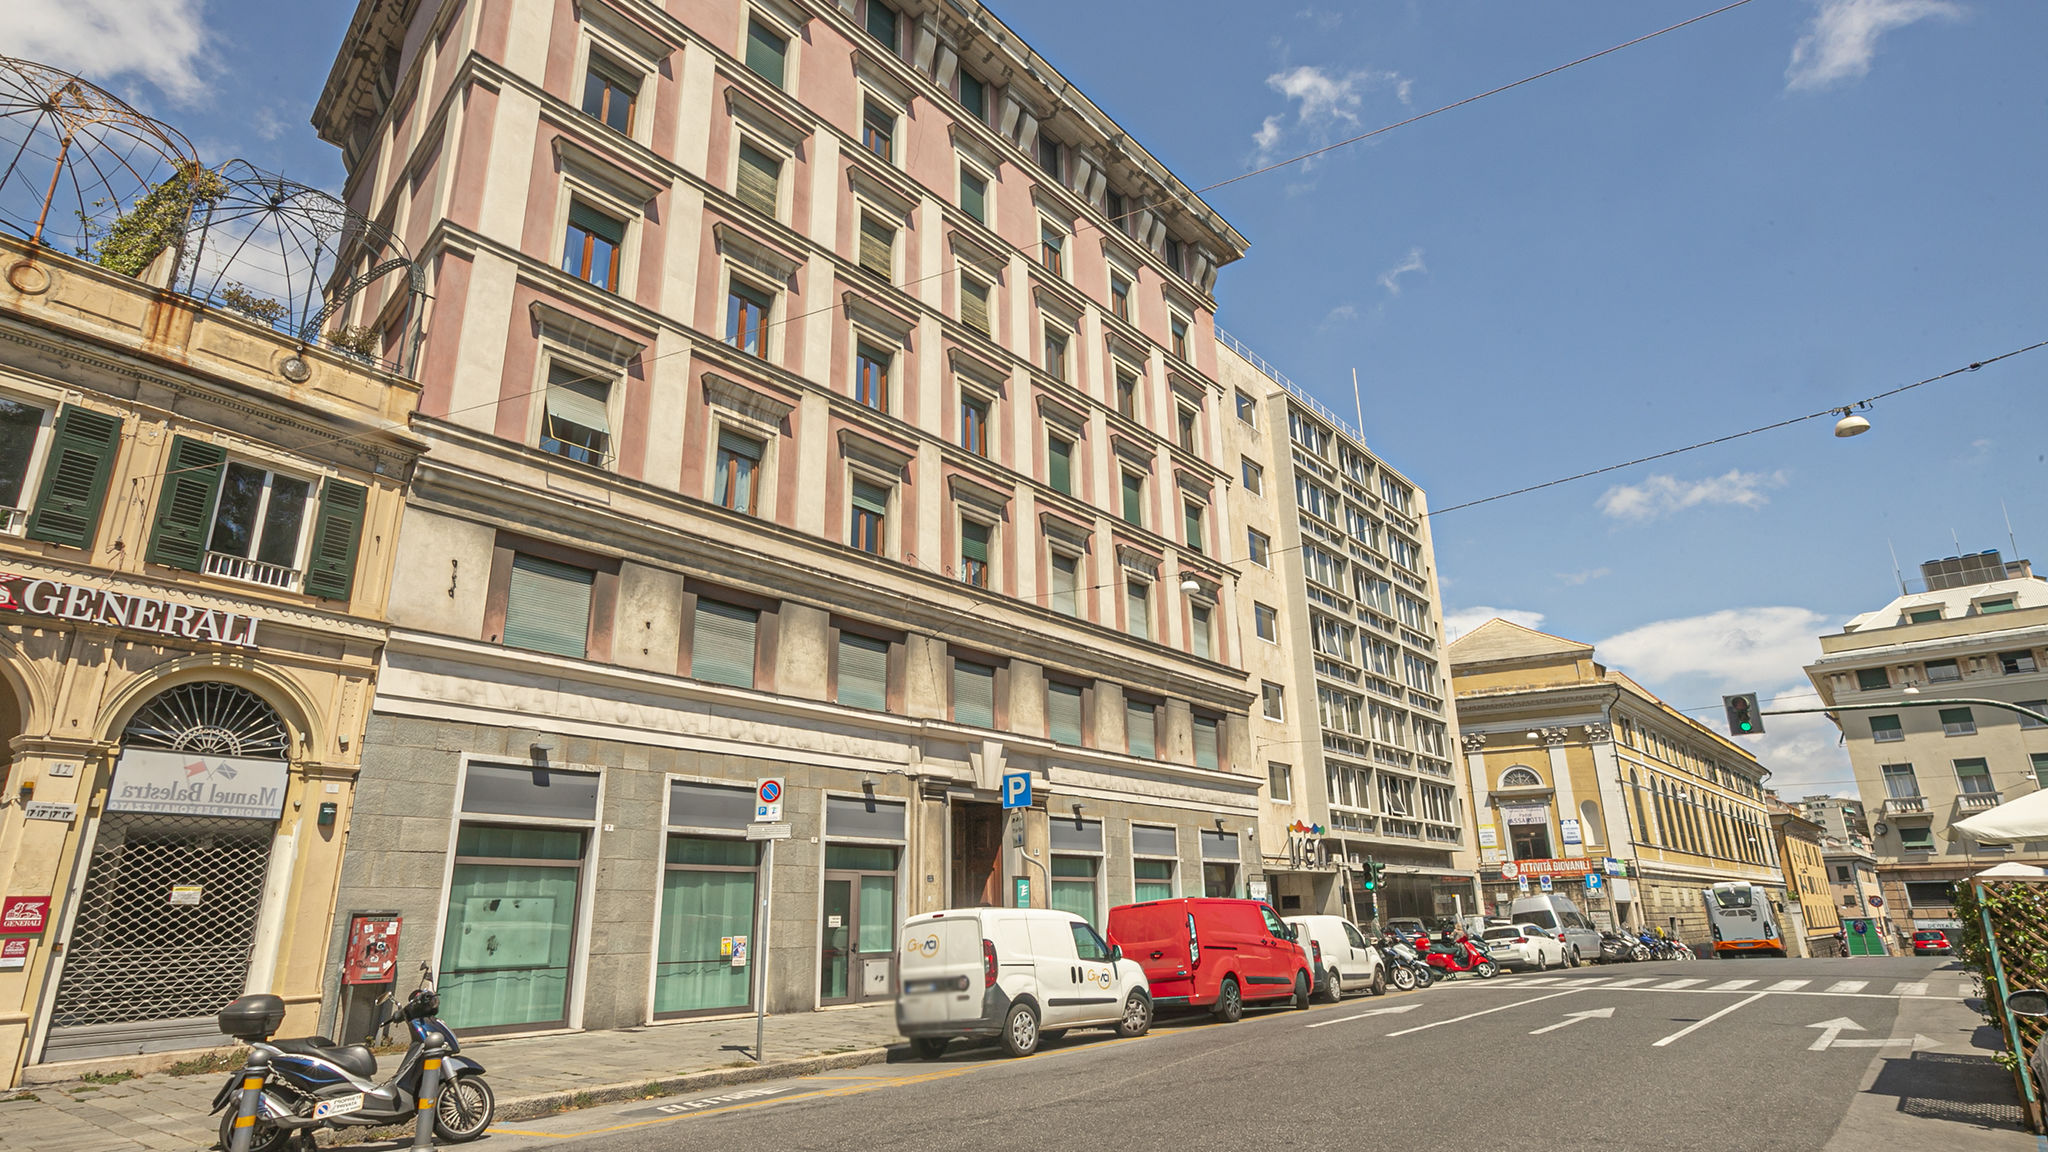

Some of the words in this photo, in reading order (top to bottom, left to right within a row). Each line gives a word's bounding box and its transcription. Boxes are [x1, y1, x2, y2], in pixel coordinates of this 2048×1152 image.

[23, 579, 261, 647] GENERALI
[1009, 777, 1026, 804] P
[1520, 861, 1553, 873] ATTIVITÀ
[1553, 860, 1591, 872] GIOVANILI
[1589, 875, 1598, 887] P
